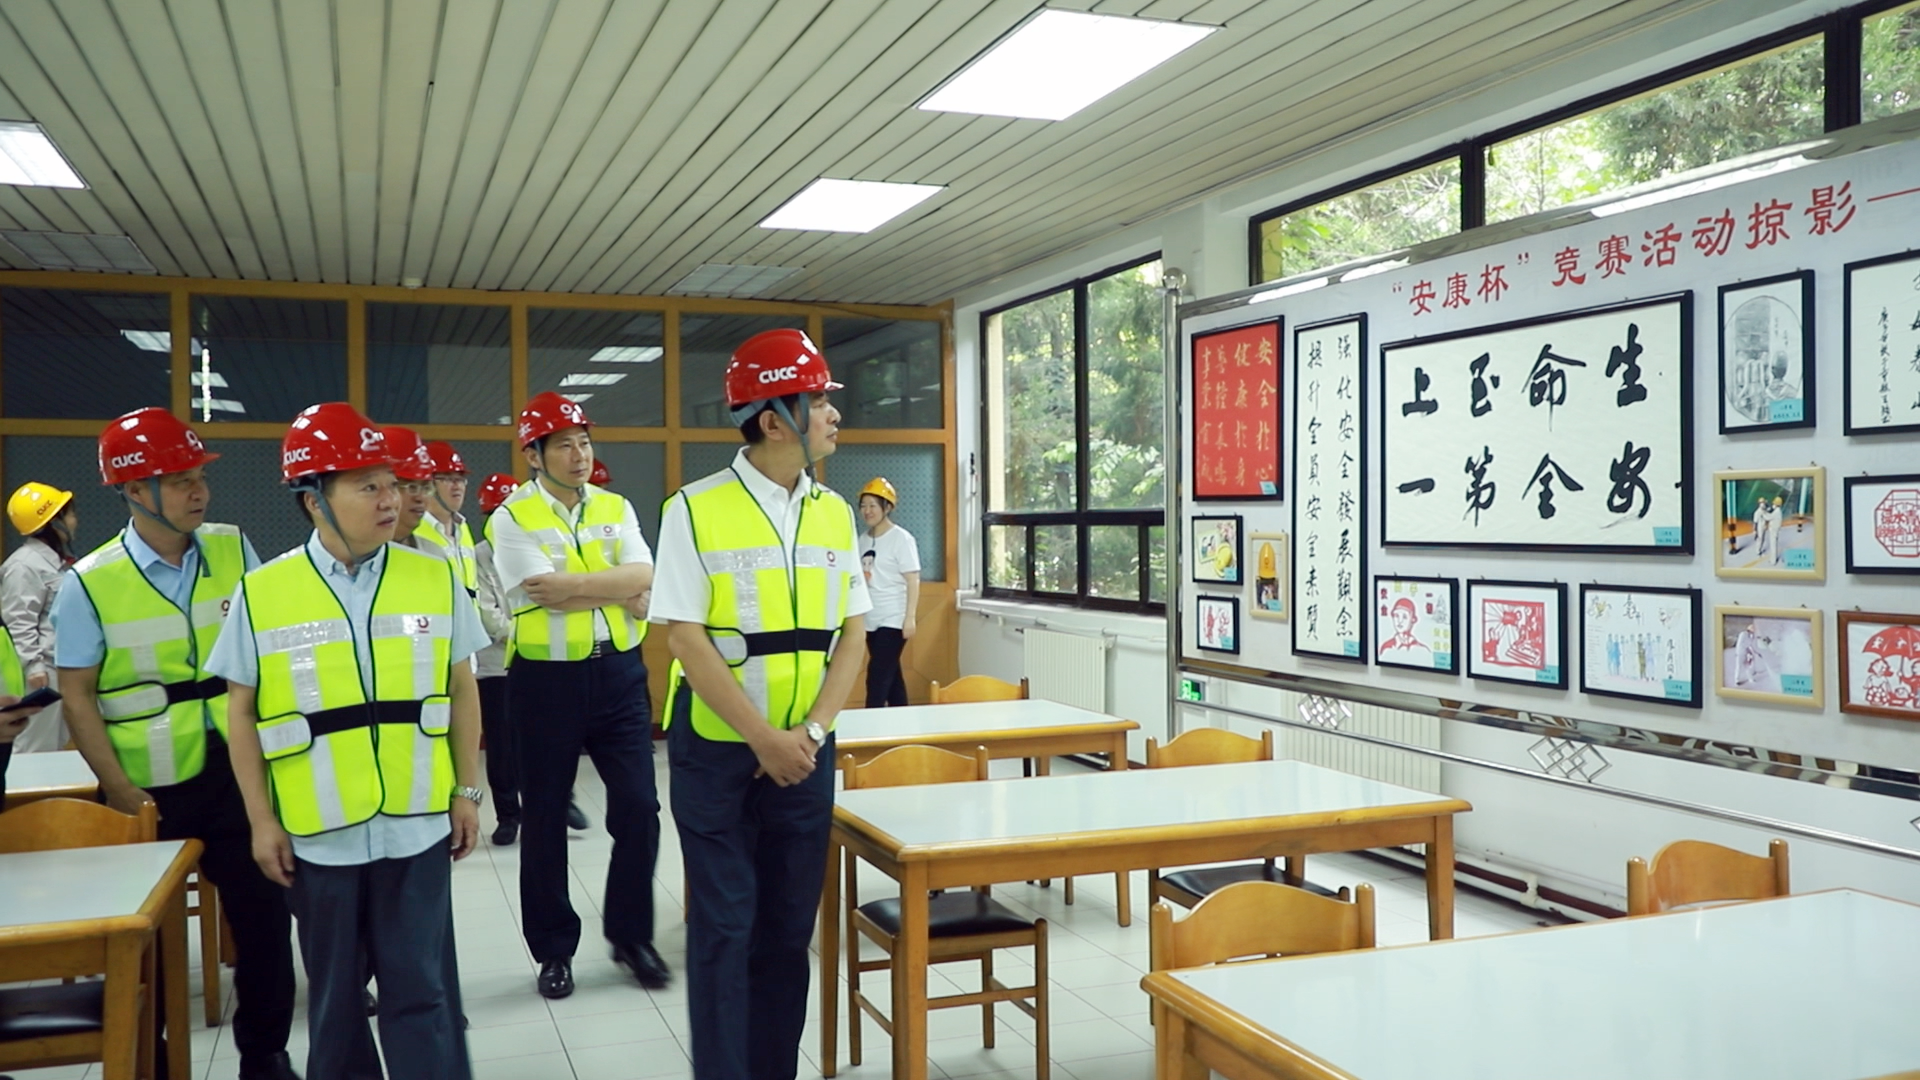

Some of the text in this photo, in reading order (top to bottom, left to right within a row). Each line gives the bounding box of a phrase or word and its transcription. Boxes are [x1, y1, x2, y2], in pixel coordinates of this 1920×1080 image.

[758, 365, 798, 384] CUCC
[111, 451, 146, 468] CUCC
[1396, 441, 1651, 529] 安全第一
